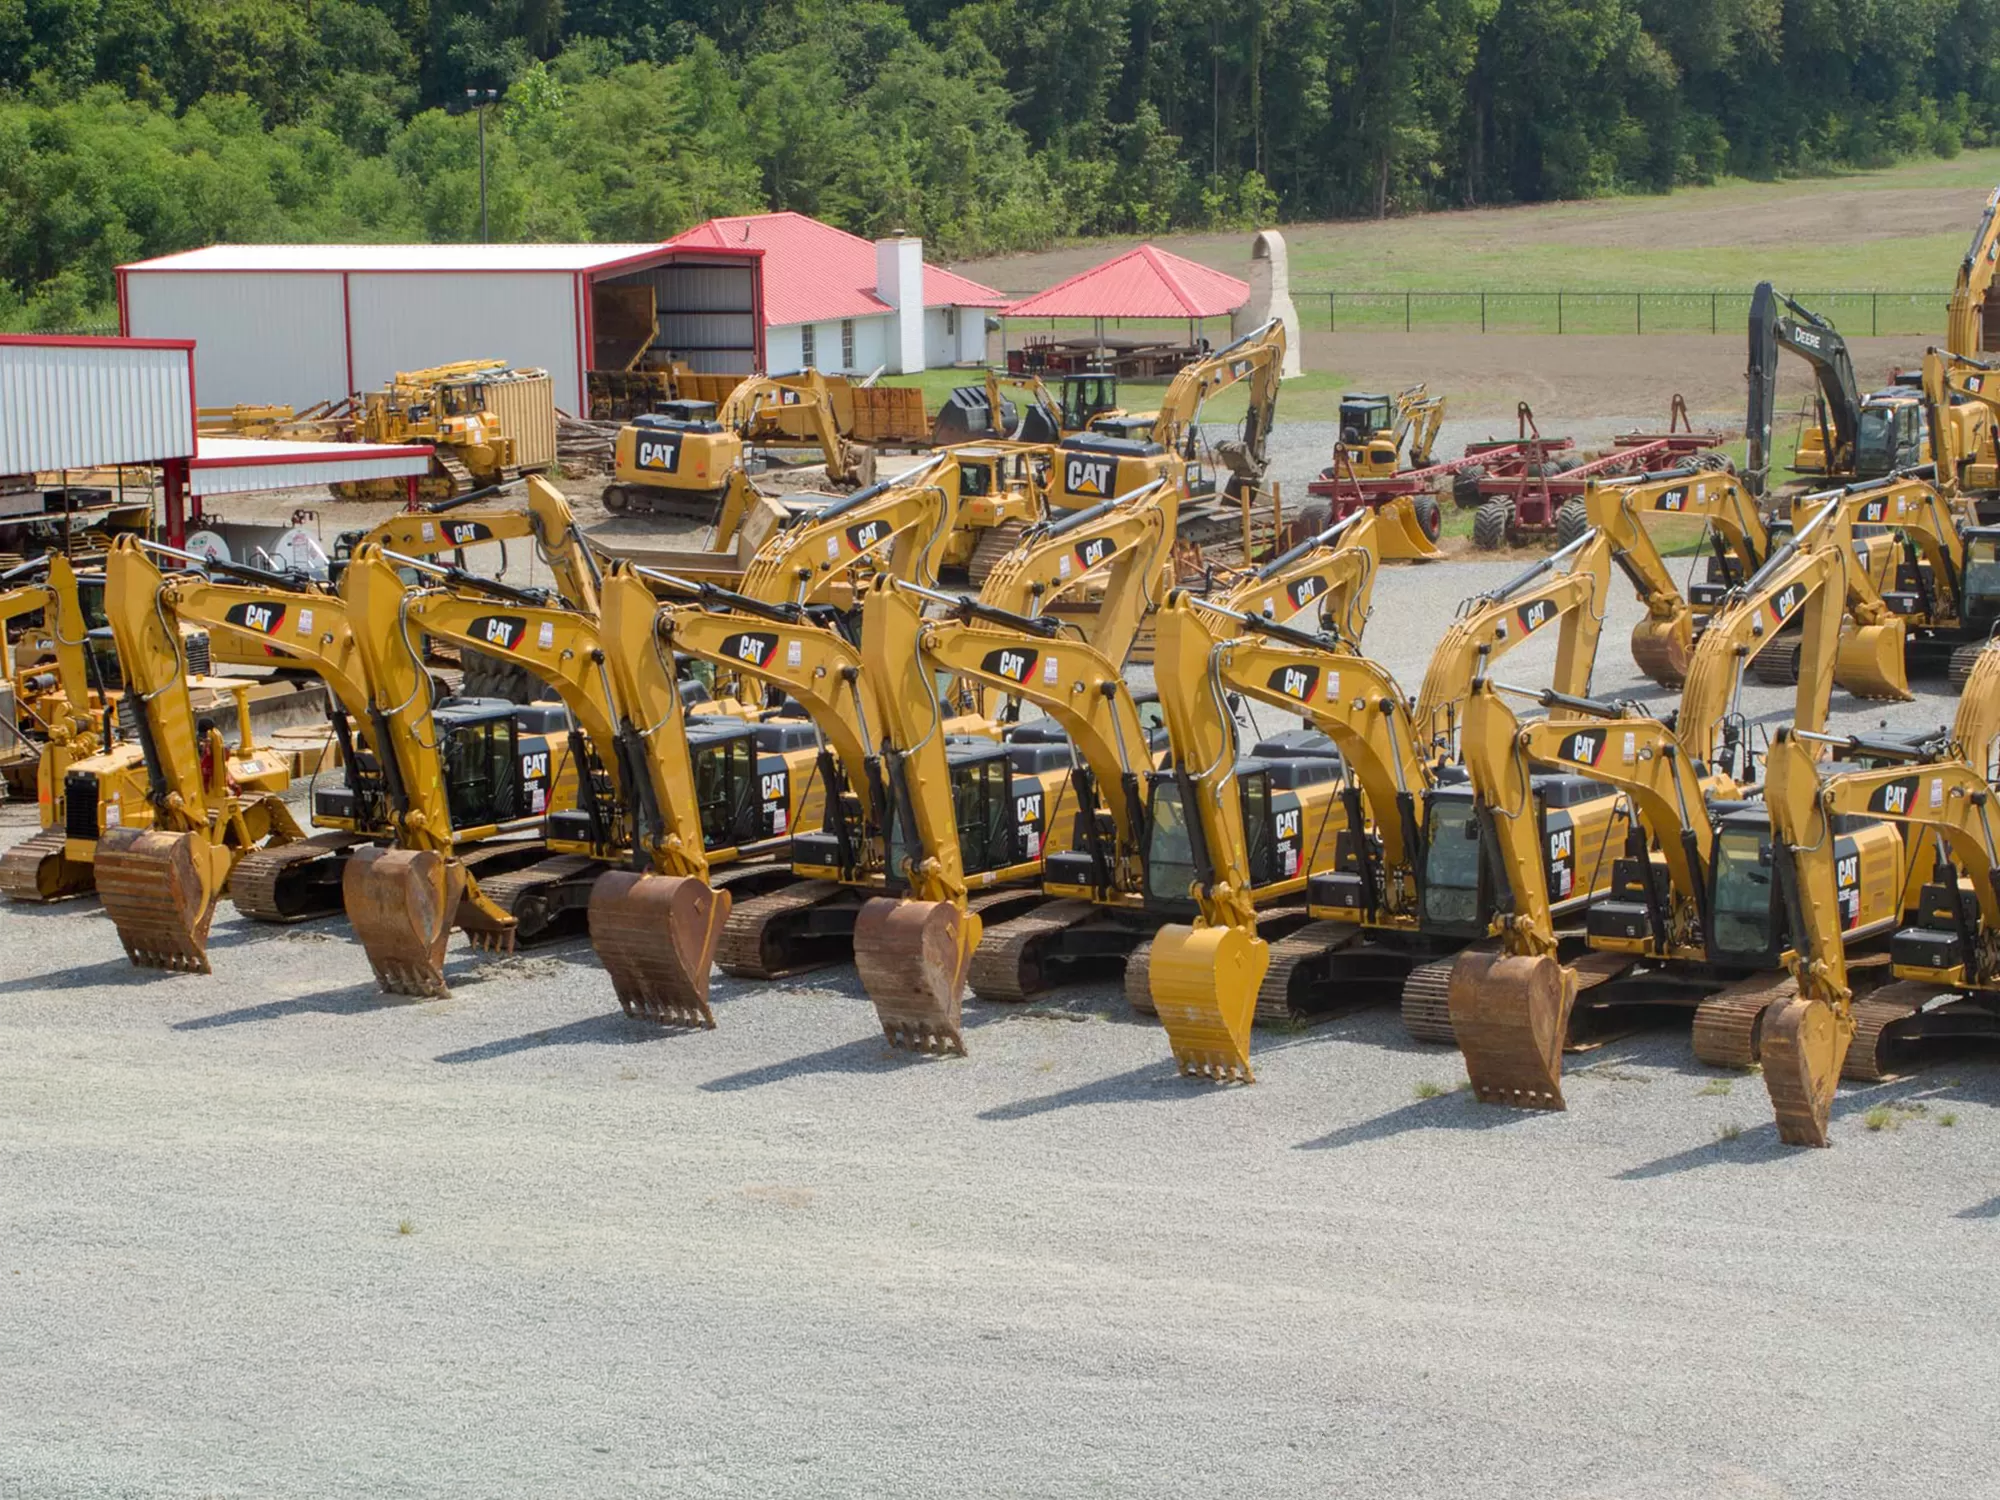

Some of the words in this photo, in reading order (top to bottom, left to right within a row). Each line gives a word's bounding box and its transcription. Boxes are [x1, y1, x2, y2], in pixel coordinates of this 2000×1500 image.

[1795, 327, 1820, 348] DEERE
[640, 443, 674, 468] CAT
[1068, 461, 1110, 493] CAT
[1666, 492, 1681, 509] CAT
[1868, 504, 1881, 520] CAT
[454, 523, 475, 543] CAT
[858, 522, 877, 548] CAT
[1086, 539, 1103, 565] CAT
[1297, 577, 1314, 605] CAT
[1779, 586, 1794, 616] CAT
[246, 605, 271, 632] CAT
[1528, 602, 1544, 629] CAT
[487, 619, 512, 647] CAT
[739, 636, 764, 663] CAT
[1000, 652, 1025, 680] CAT
[1284, 668, 1307, 699] CAT
[1574, 735, 1595, 764] CAT
[523, 753, 547, 778] CAT
[762, 774, 785, 799] CAT
[1885, 785, 1907, 812] CAT
[1018, 795, 1041, 822] CAT
[1276, 810, 1298, 839] CAT
[1551, 832, 1571, 860] CAT
[1839, 857, 1857, 887] CAT
